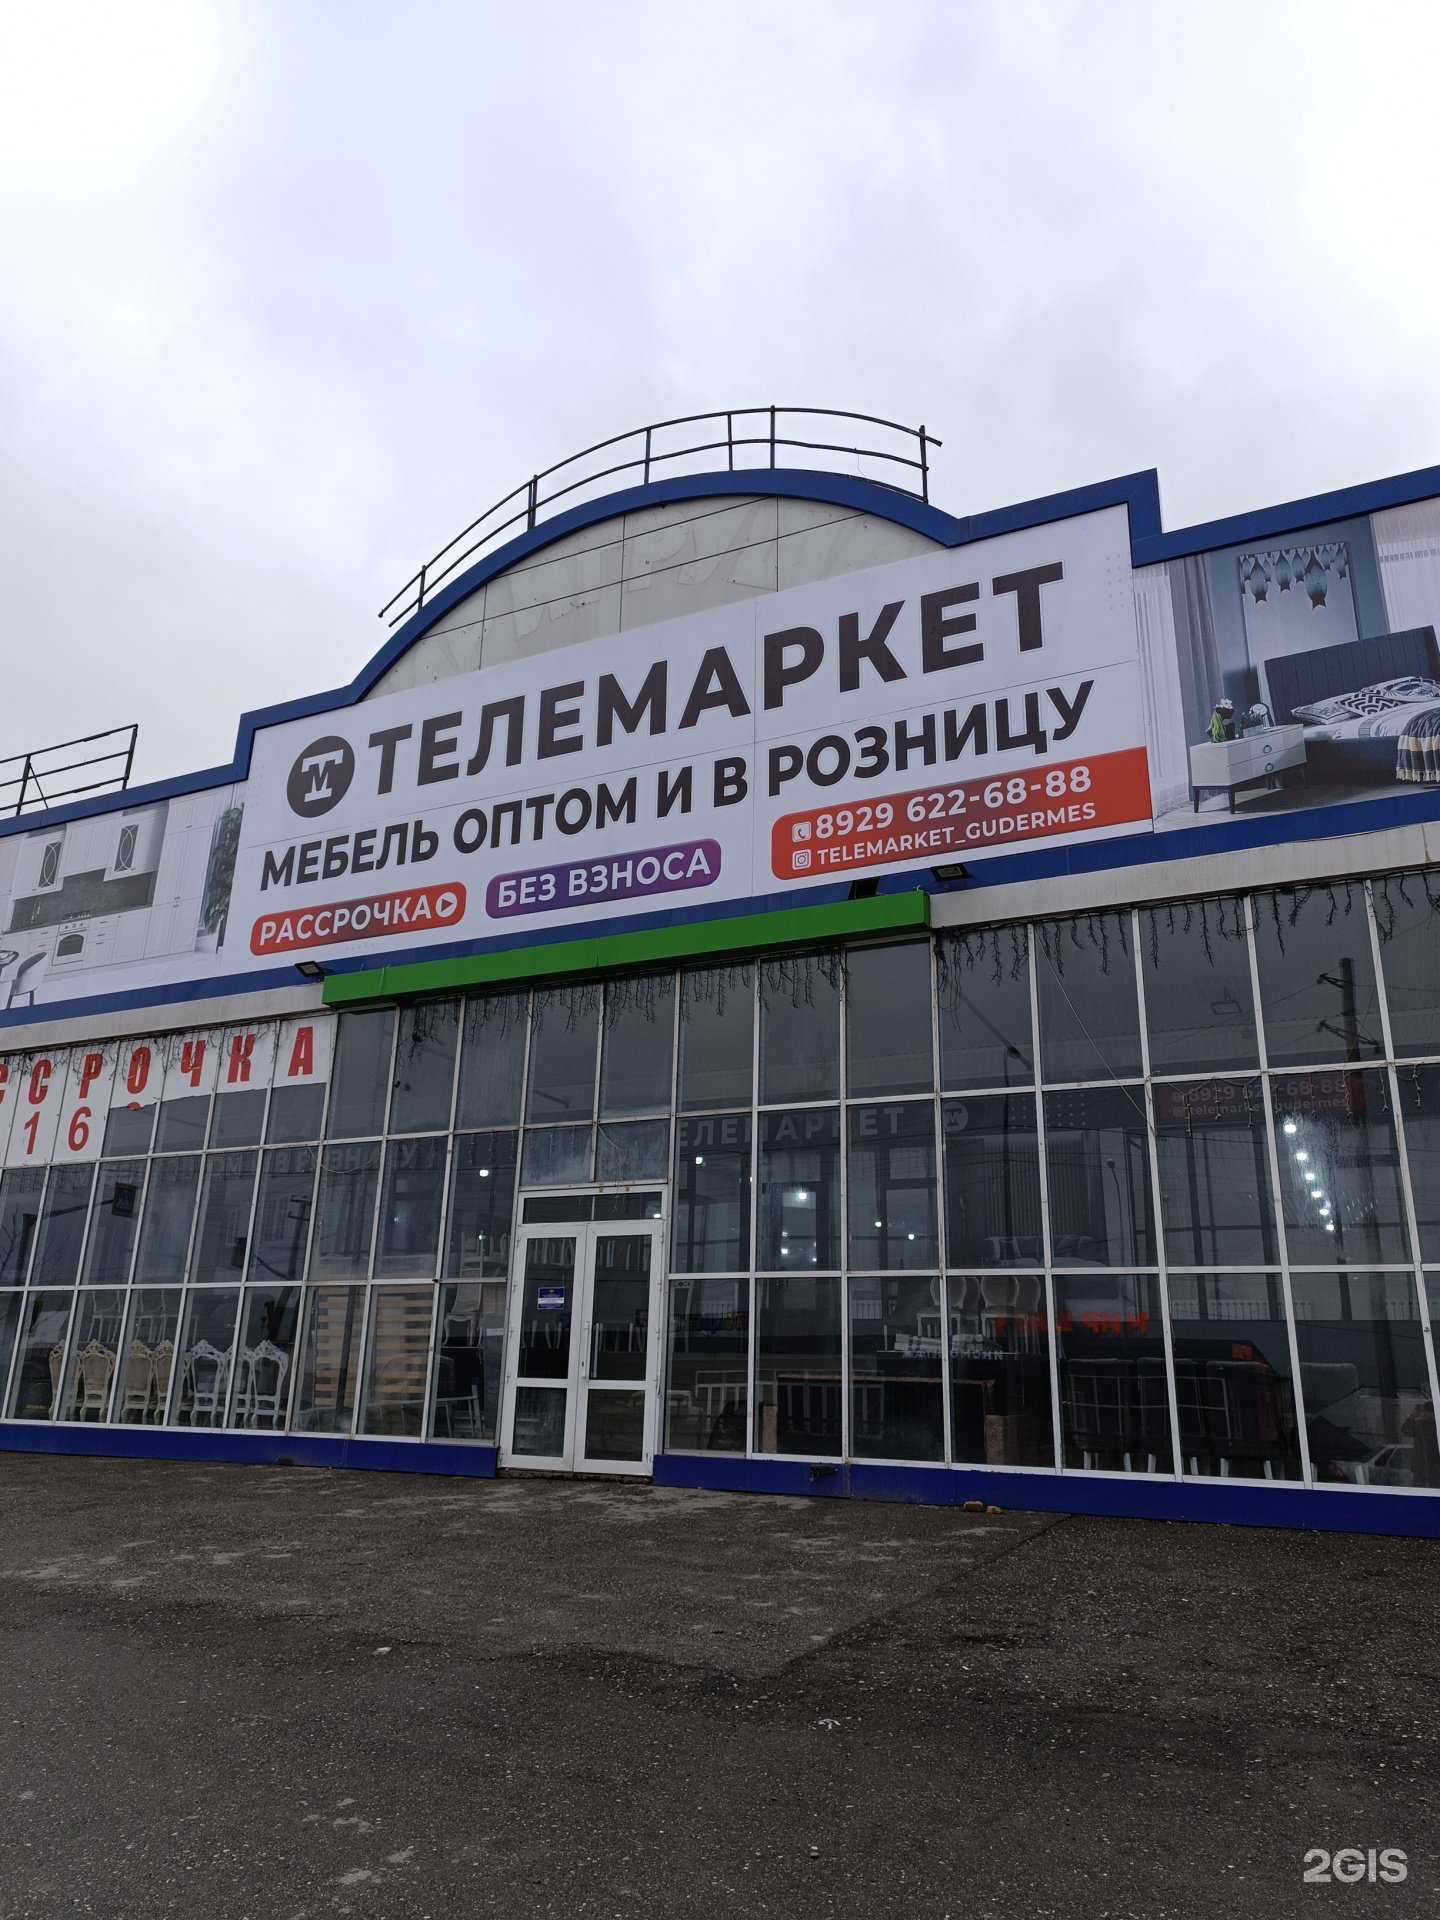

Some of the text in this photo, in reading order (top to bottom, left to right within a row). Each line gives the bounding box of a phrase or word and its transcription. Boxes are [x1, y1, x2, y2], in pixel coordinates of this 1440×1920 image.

[368, 561, 1063, 795] ТЕЛЕМАРКЕТ
[260, 679, 1094, 891] МЕБЕЛЬ ОПТОМ И В РОЗНИЦУ
[815, 765, 1092, 840] 8929 622-68-88
[817, 802, 1096, 865] TELEMARKET_GUDERMES
[497, 847, 711, 908] БЕЗ ВЗНОСА
[259, 895, 432, 946] РАССРОЧКА
[24, 1106, 92, 1155] 16
